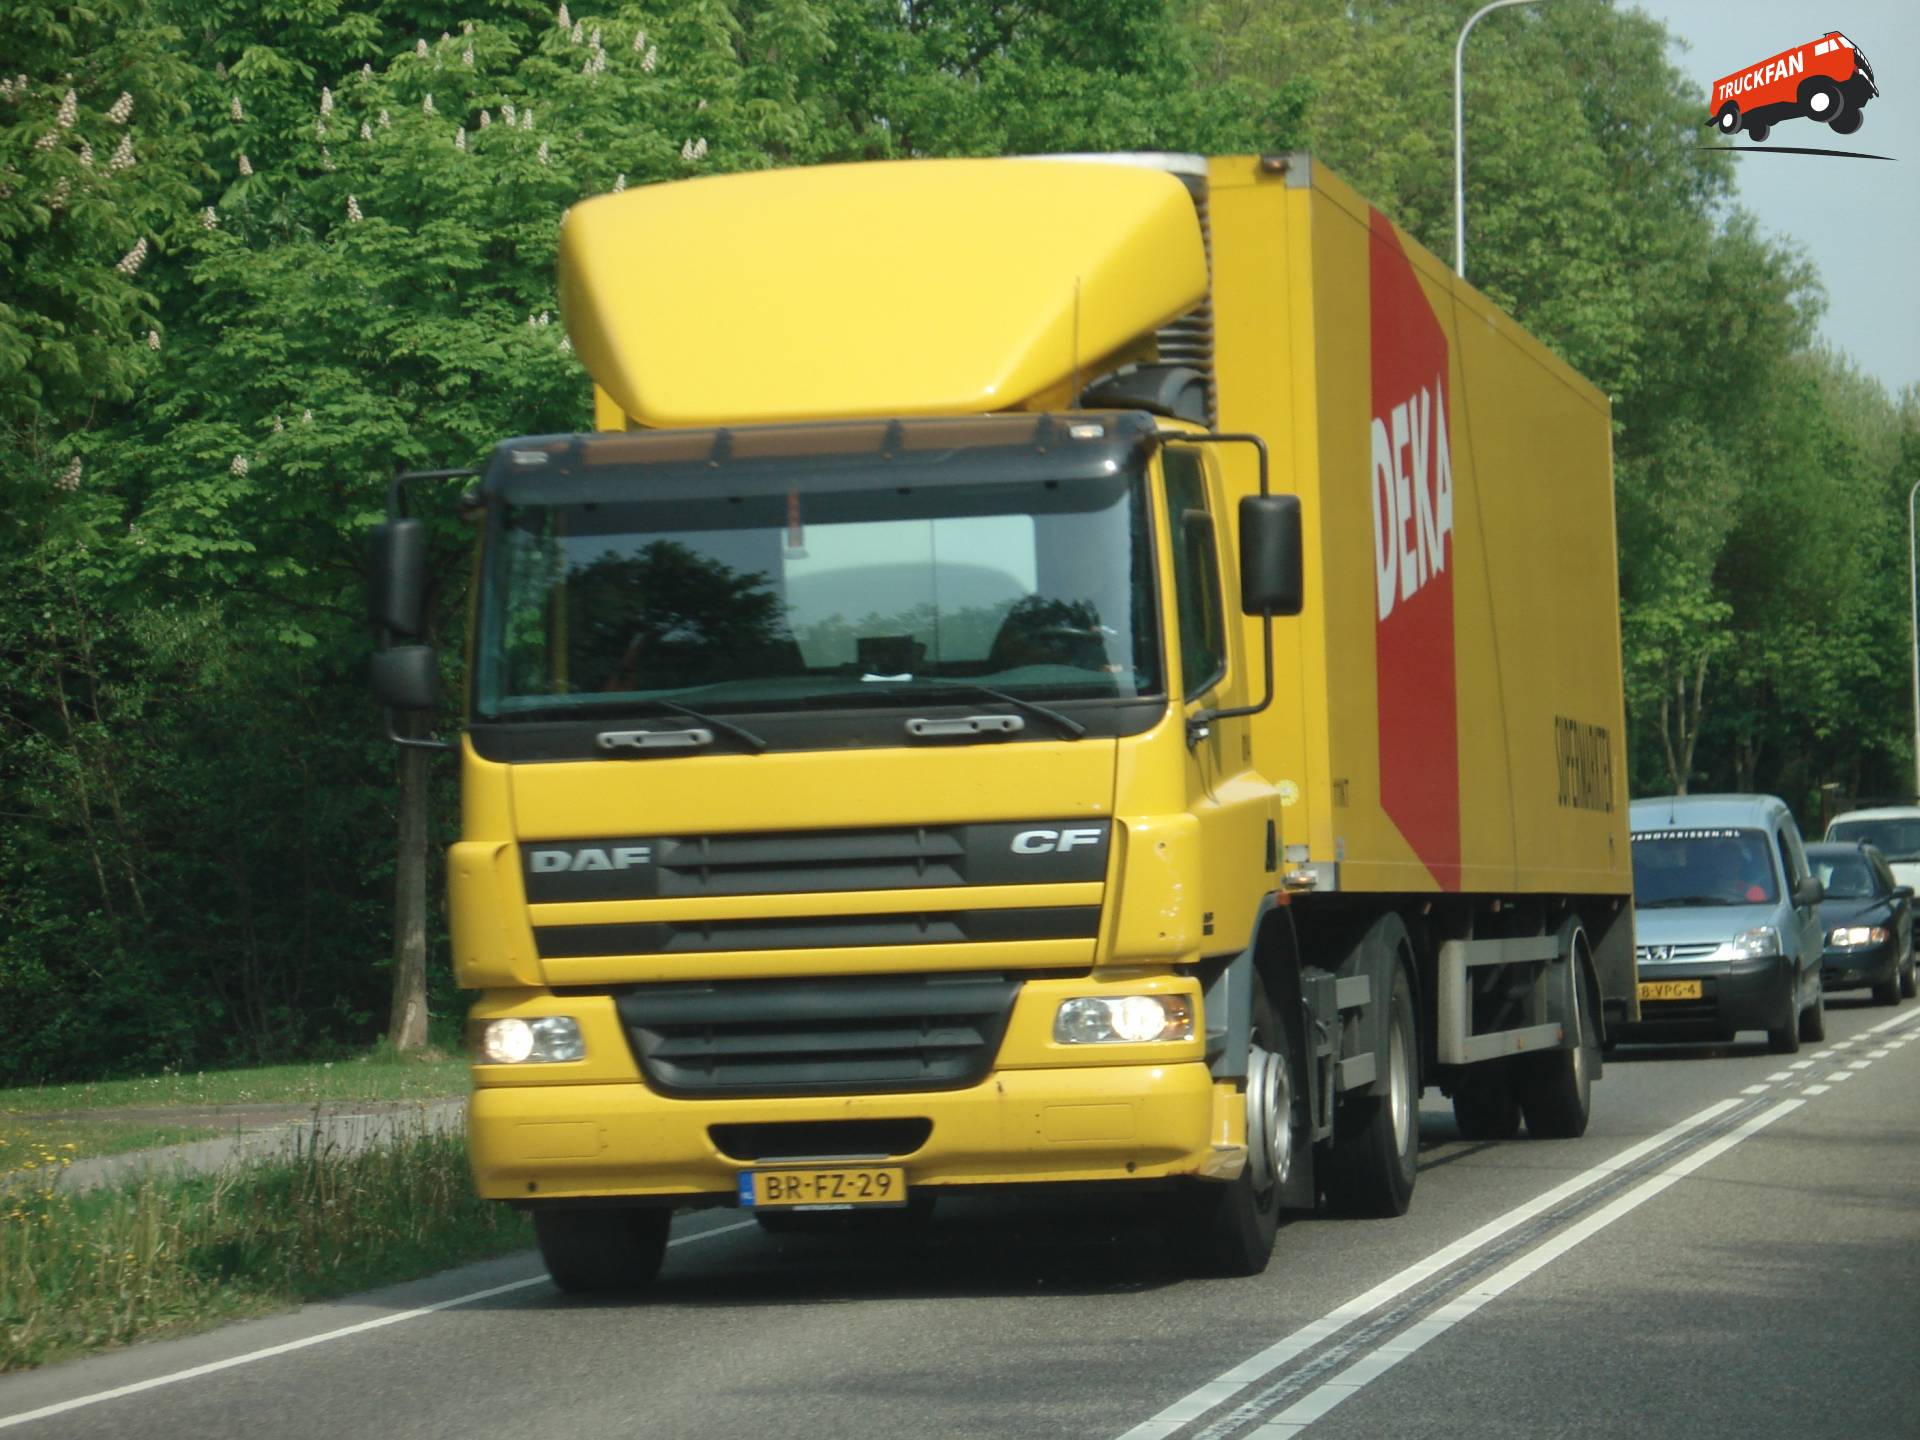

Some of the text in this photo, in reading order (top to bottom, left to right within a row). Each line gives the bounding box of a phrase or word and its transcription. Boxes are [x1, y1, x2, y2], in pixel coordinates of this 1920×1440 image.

[1371, 371, 1453, 622] DEKA
[1010, 828, 1102, 854] CF
[530, 847, 650, 873] DAF
[765, 1172, 892, 1200] BR-FZ-29
